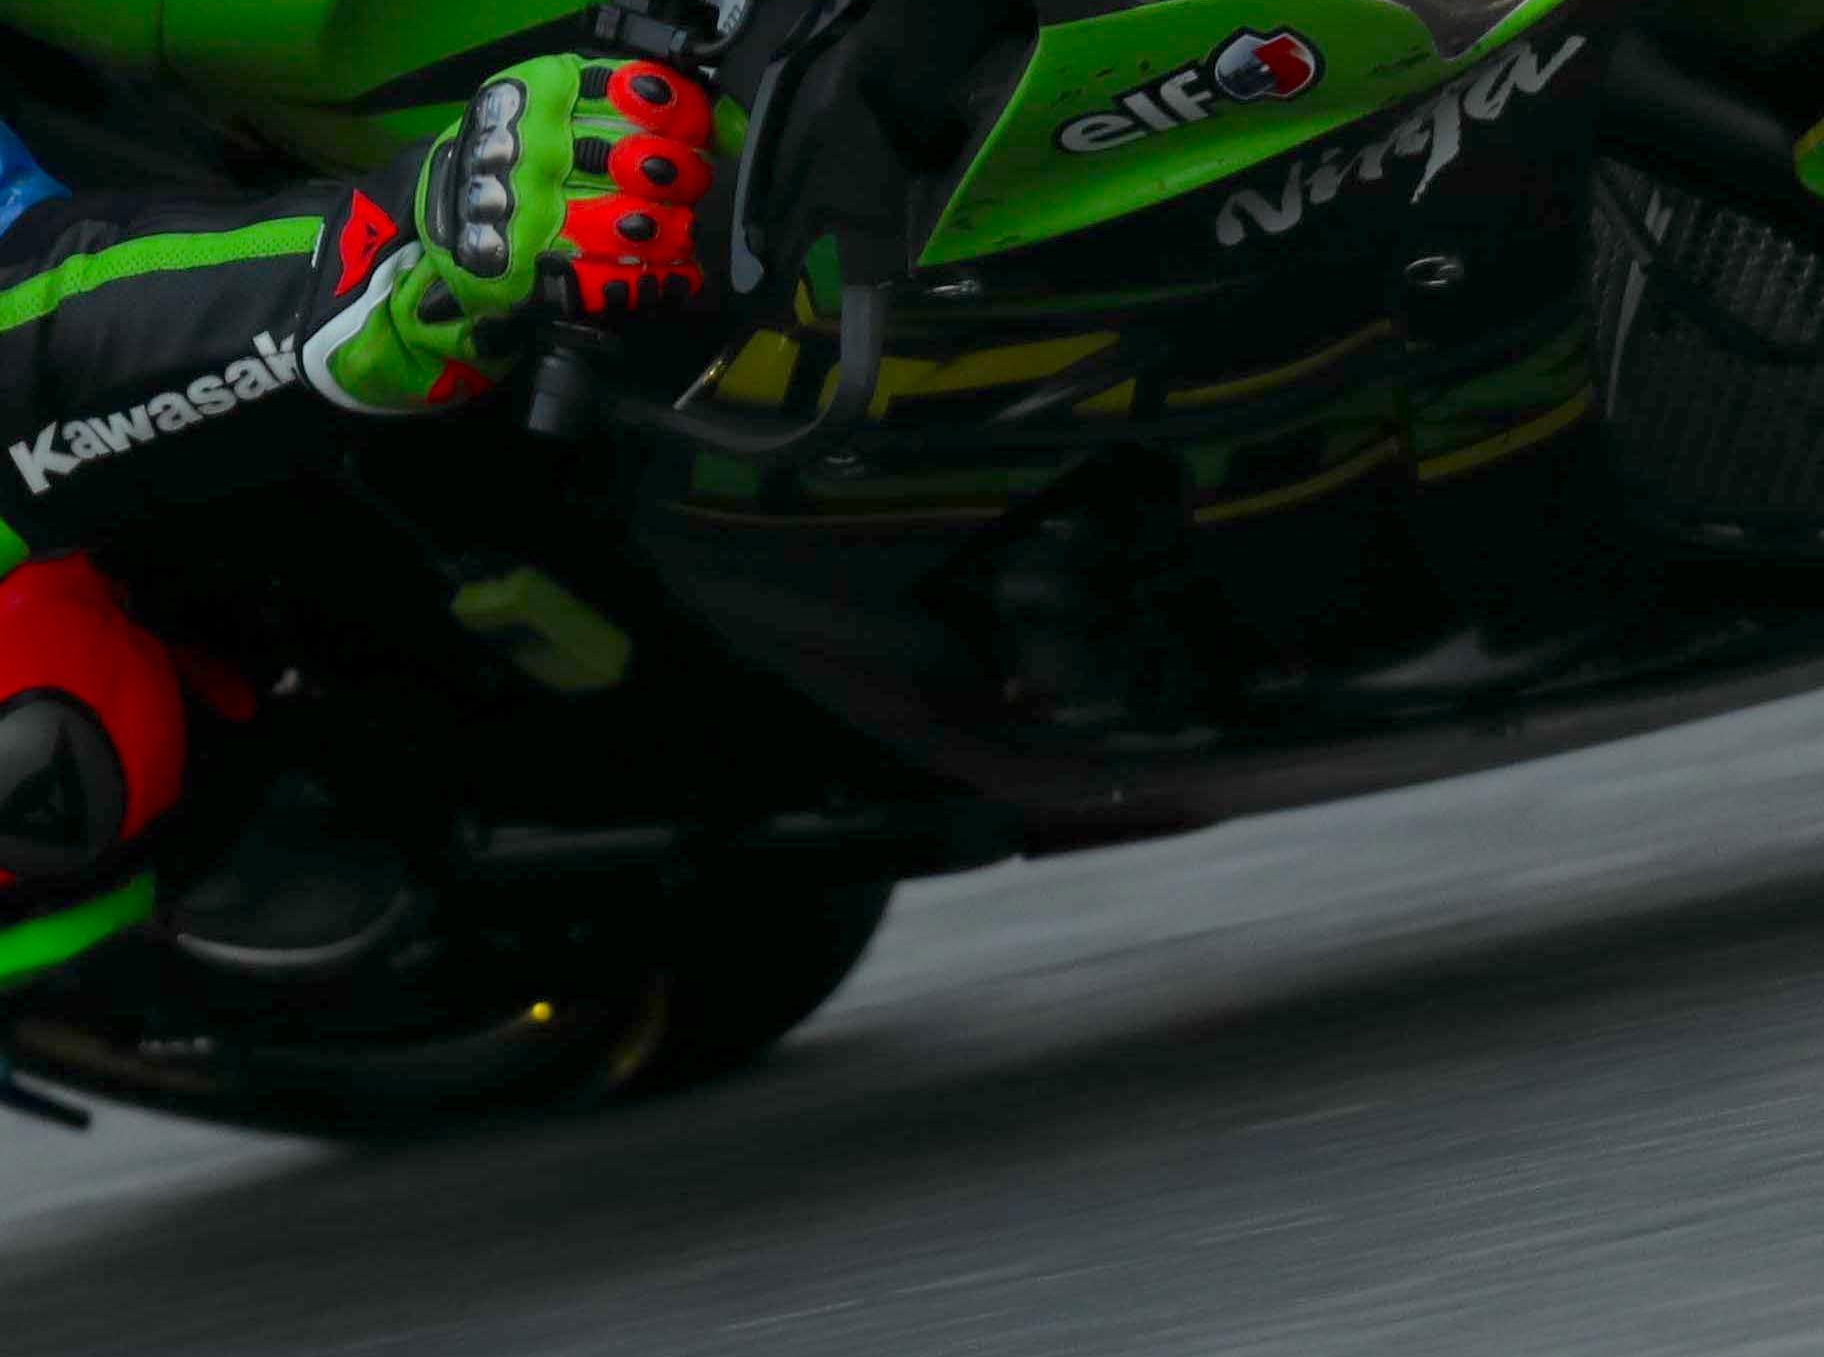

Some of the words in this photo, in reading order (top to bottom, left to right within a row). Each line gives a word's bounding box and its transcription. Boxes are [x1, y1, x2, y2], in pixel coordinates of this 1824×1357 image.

[1061, 68, 1217, 152] elf
[1216, 35, 1586, 245] Ninja
[9, 329, 299, 495] Kawasak
